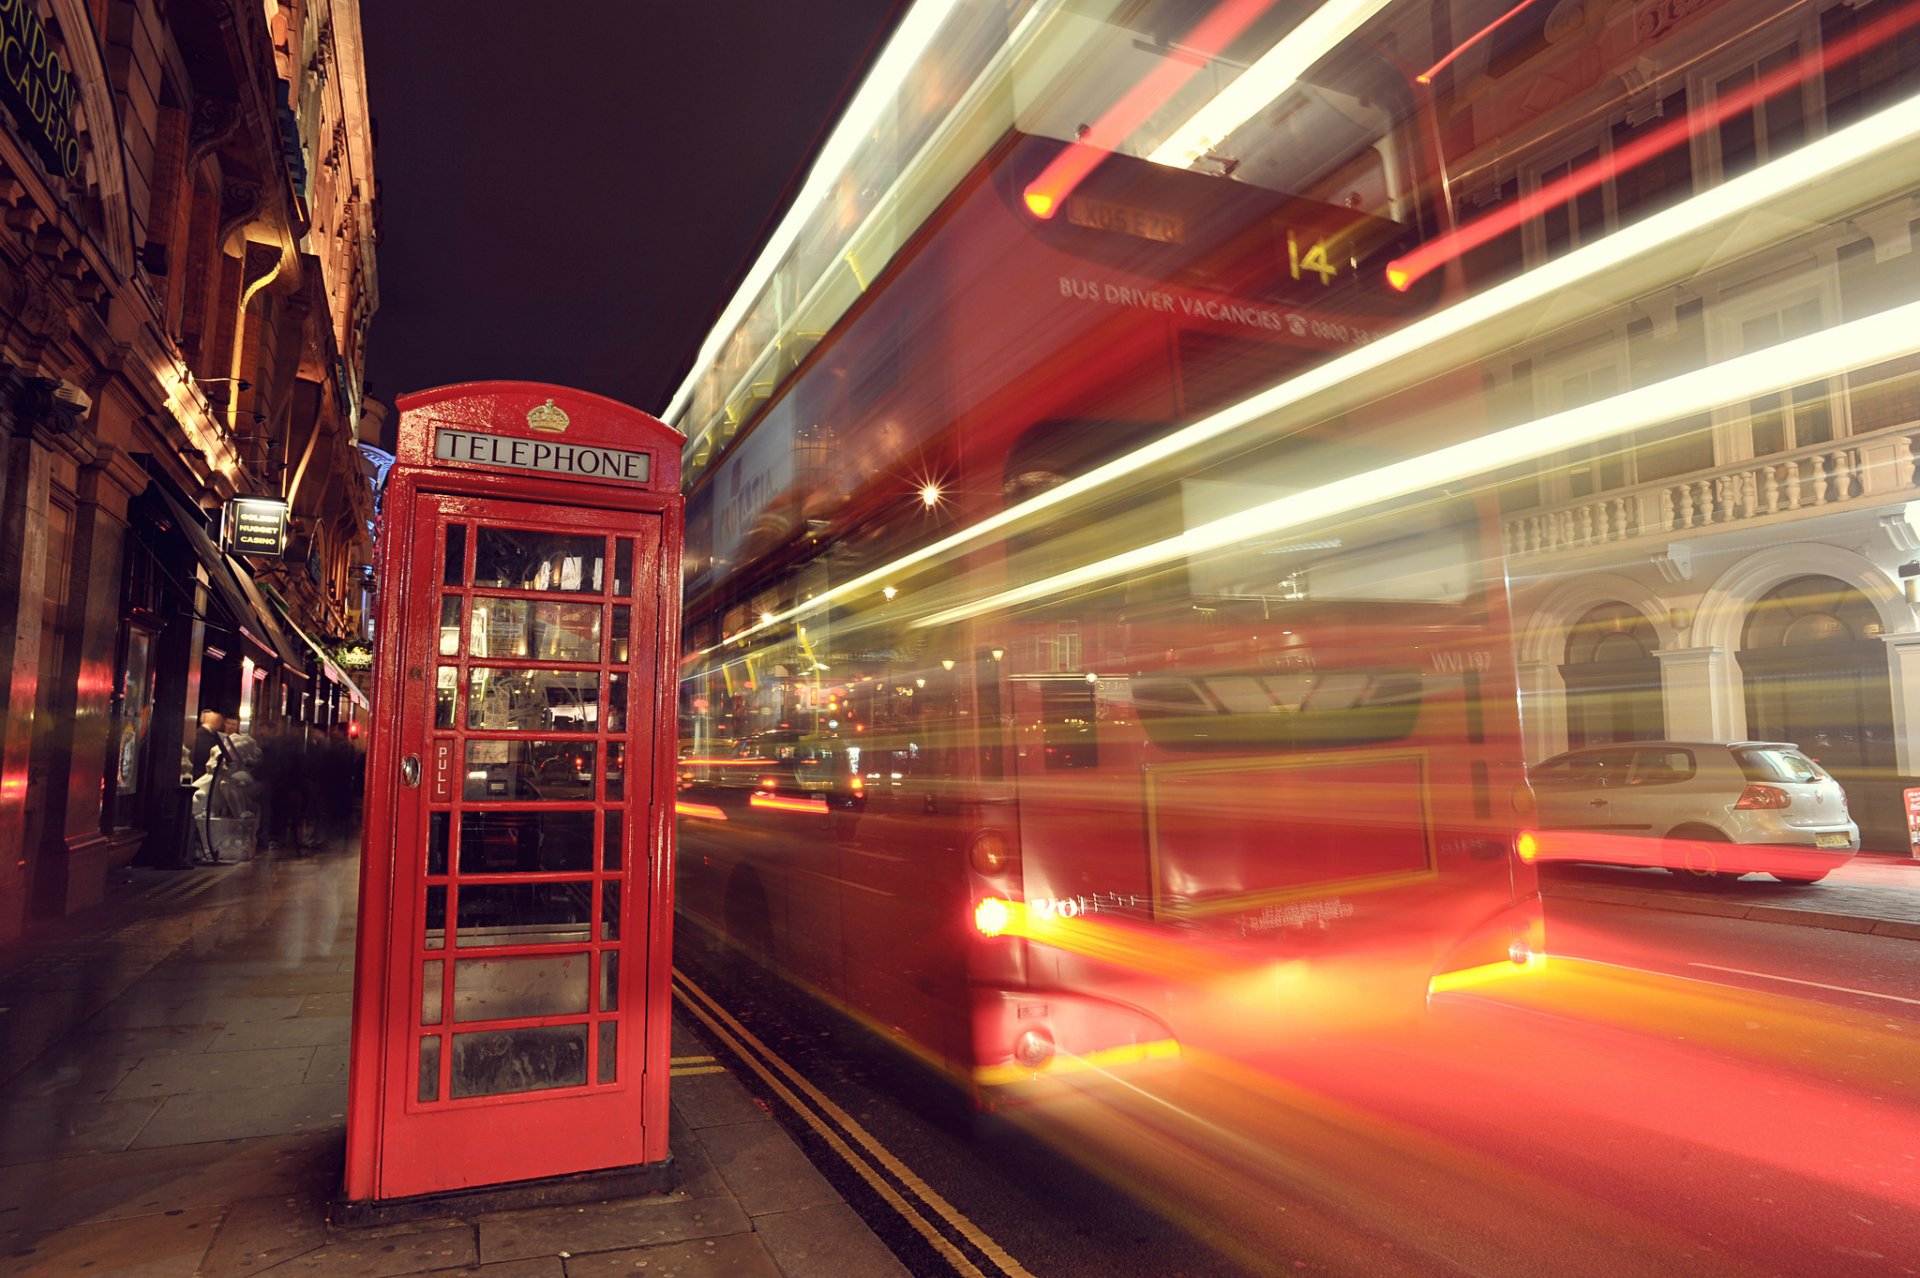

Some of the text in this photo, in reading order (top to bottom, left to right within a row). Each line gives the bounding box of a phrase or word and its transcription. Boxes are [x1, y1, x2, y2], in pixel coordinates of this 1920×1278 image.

[0, 12, 79, 178] CADERO
[1287, 232, 1337, 287] 14
[1059, 276, 1099, 300] BUS
[1105, 283, 1176, 314] DRIVER
[1178, 296, 1283, 331] VACANCIES
[443, 432, 640, 479] TELEPHONE
[239, 524, 279, 534] NUGGET
[240, 535, 276, 545] CASINO
[437, 746, 447, 795] PULL
